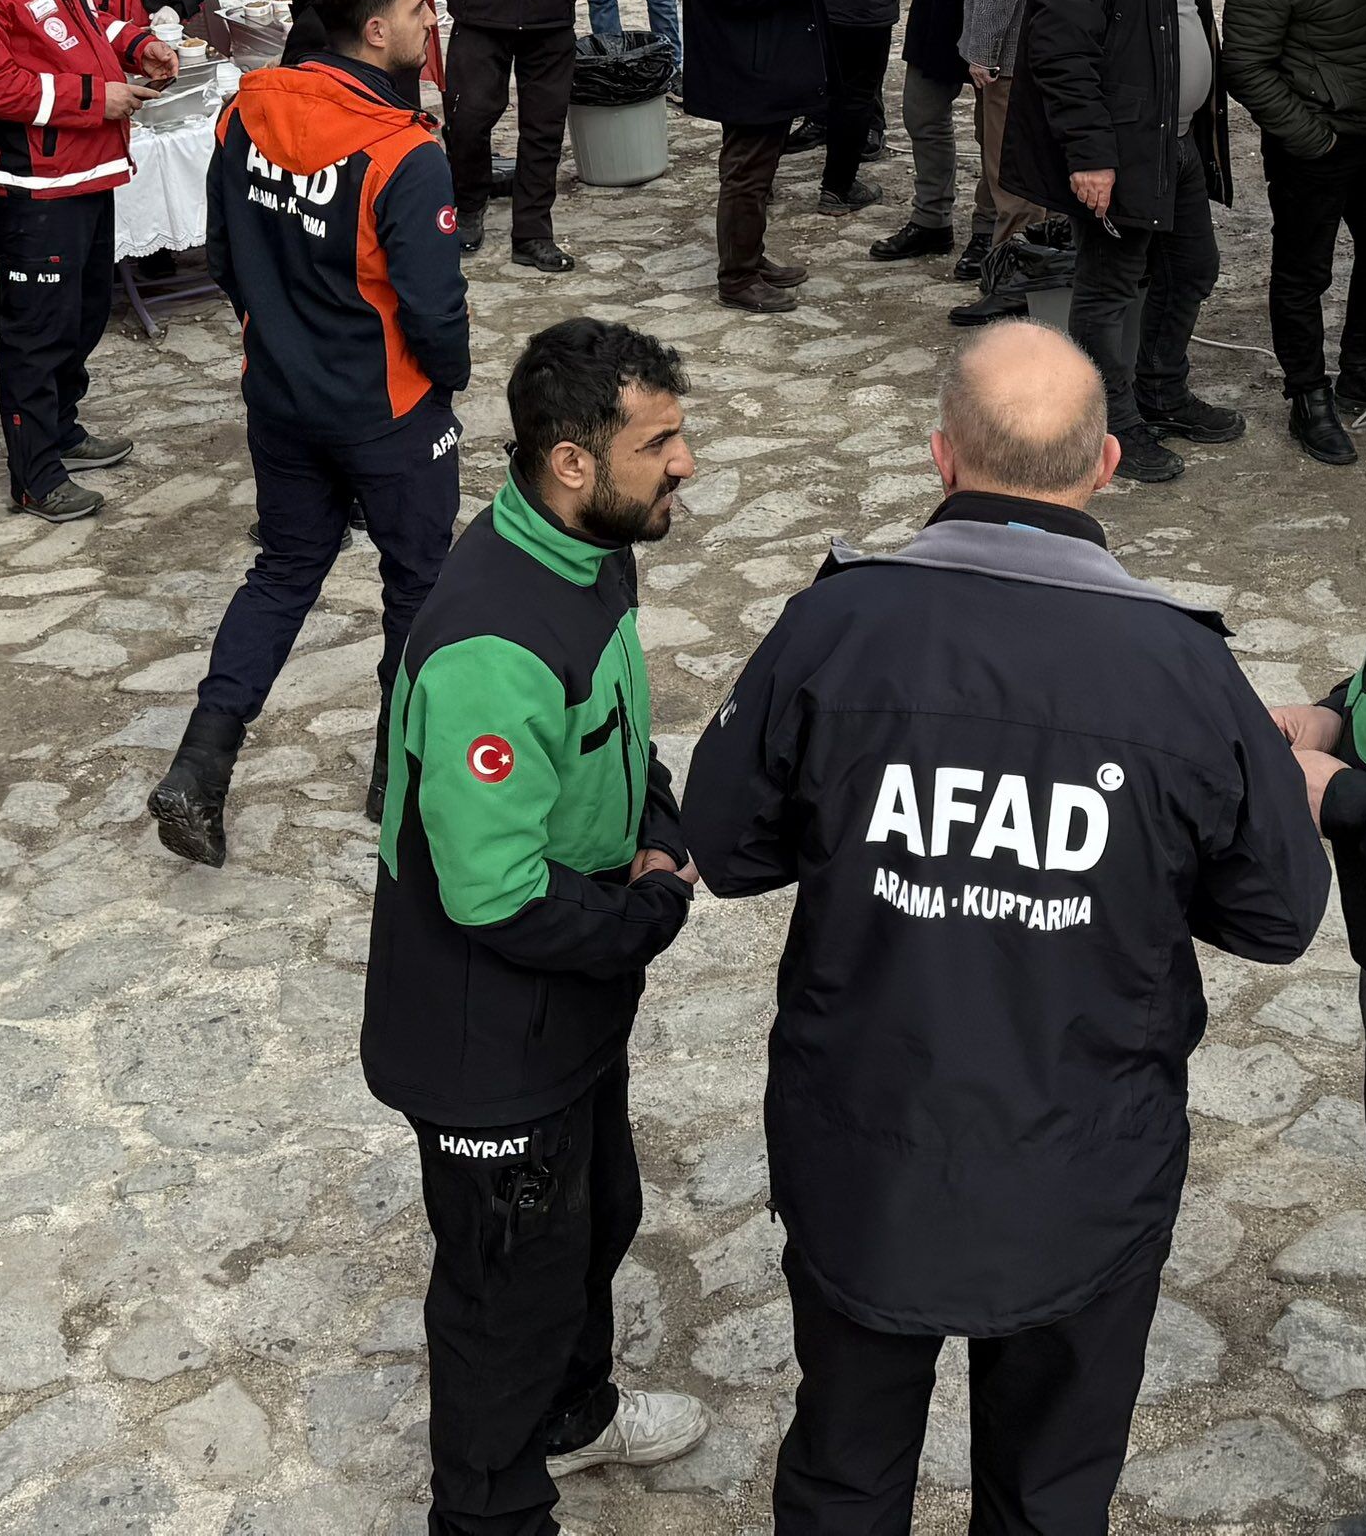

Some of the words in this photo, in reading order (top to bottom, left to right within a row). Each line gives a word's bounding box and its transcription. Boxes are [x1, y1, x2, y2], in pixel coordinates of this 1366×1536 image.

[865, 763, 1110, 872] AFAD
[873, 867, 946, 919] ARAMA
[962, 884, 1092, 931] KURTARMA
[439, 1134, 529, 1159] HAYRAT
